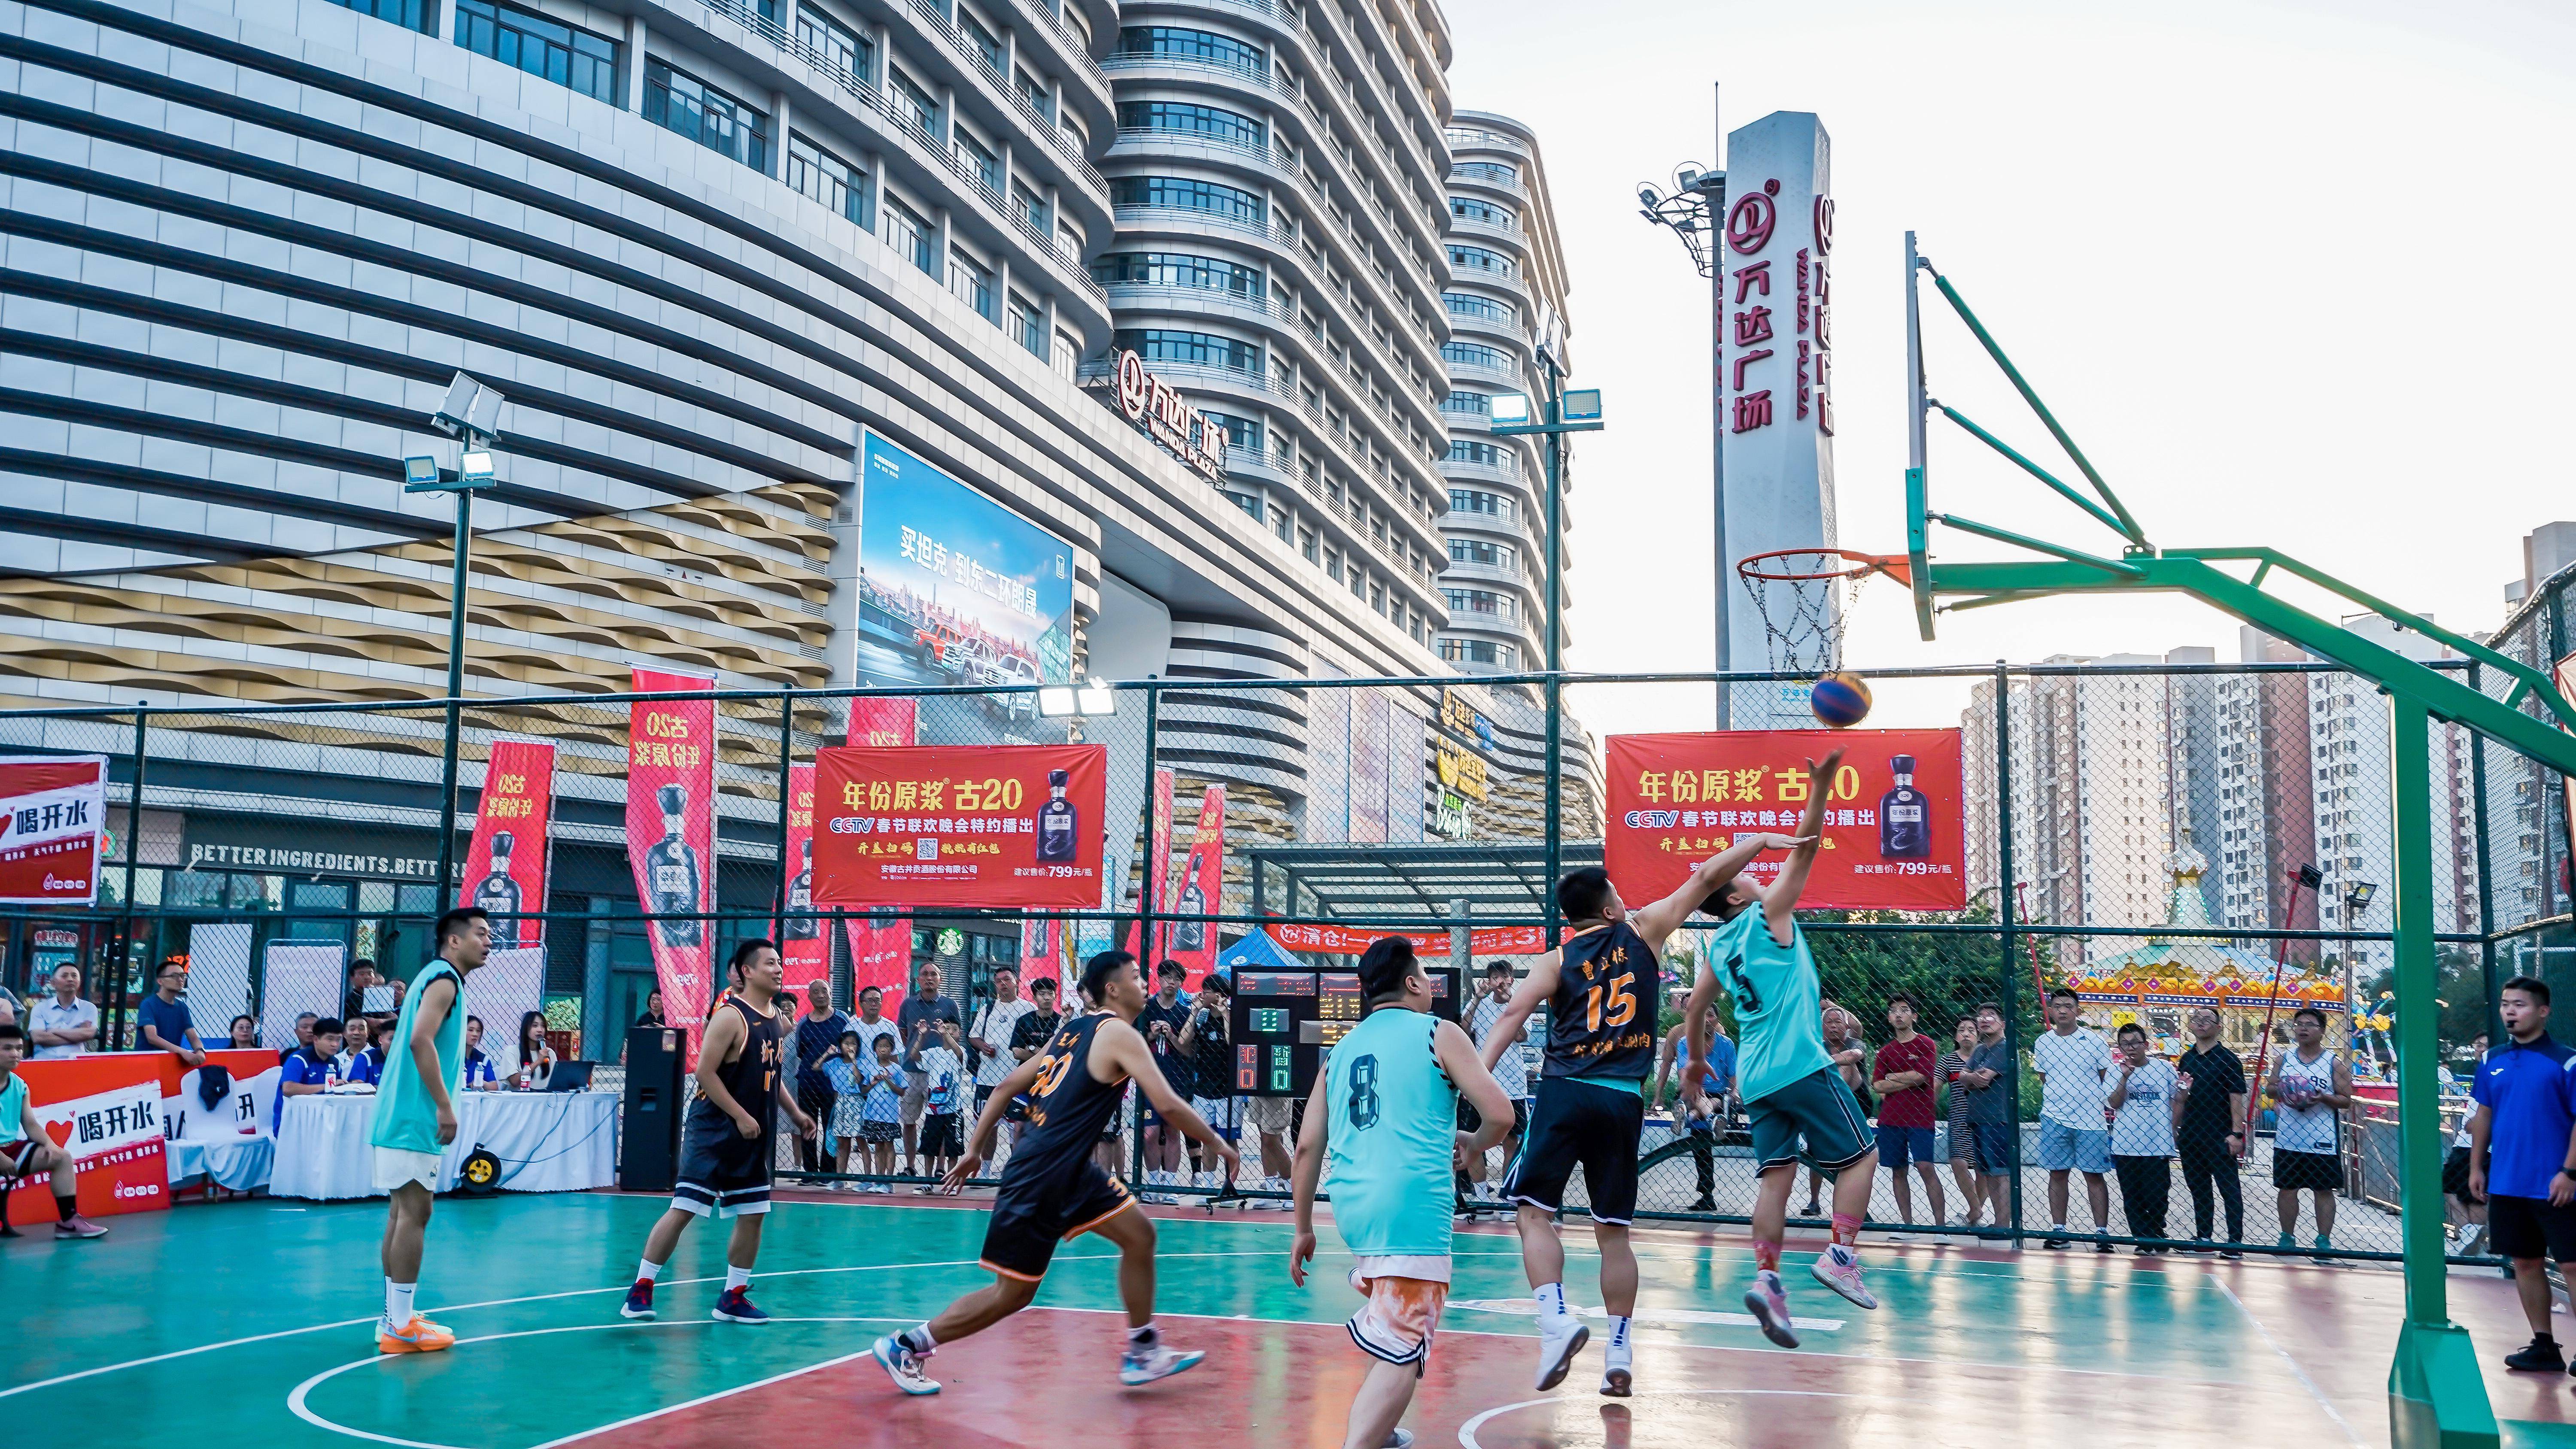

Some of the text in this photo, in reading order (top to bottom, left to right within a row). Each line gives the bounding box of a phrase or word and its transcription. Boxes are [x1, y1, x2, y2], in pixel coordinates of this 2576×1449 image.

[1733, 260, 1774, 433] 万达广场
[1796, 247, 1809, 421] WANDA PLAZA
[1149, 417, 1218, 481] WANDA PLAZA
[900, 524, 948, 577] 买坦克
[842, 778, 1023, 811] 年份原浆 古20
[1639, 765, 1860, 803] 年份原浆 古0
[17, 800, 88, 835] 喝开水
[829, 817, 1033, 834] CCTV 春节联欢晚会特约播出
[1625, 810, 1679, 828] CCTV
[191, 843, 266, 865] BETTER
[1659, 837, 1729, 852] 开盖扫码
[1587, 971, 1636, 1033] 15
[1726, 953, 1762, 1015] 5
[1239, 1069, 1254, 1088] 0
[1273, 1070, 1288, 1090] 0
[1349, 1054, 1380, 1131] 8
[78, 1100, 155, 1144] 喝开水
